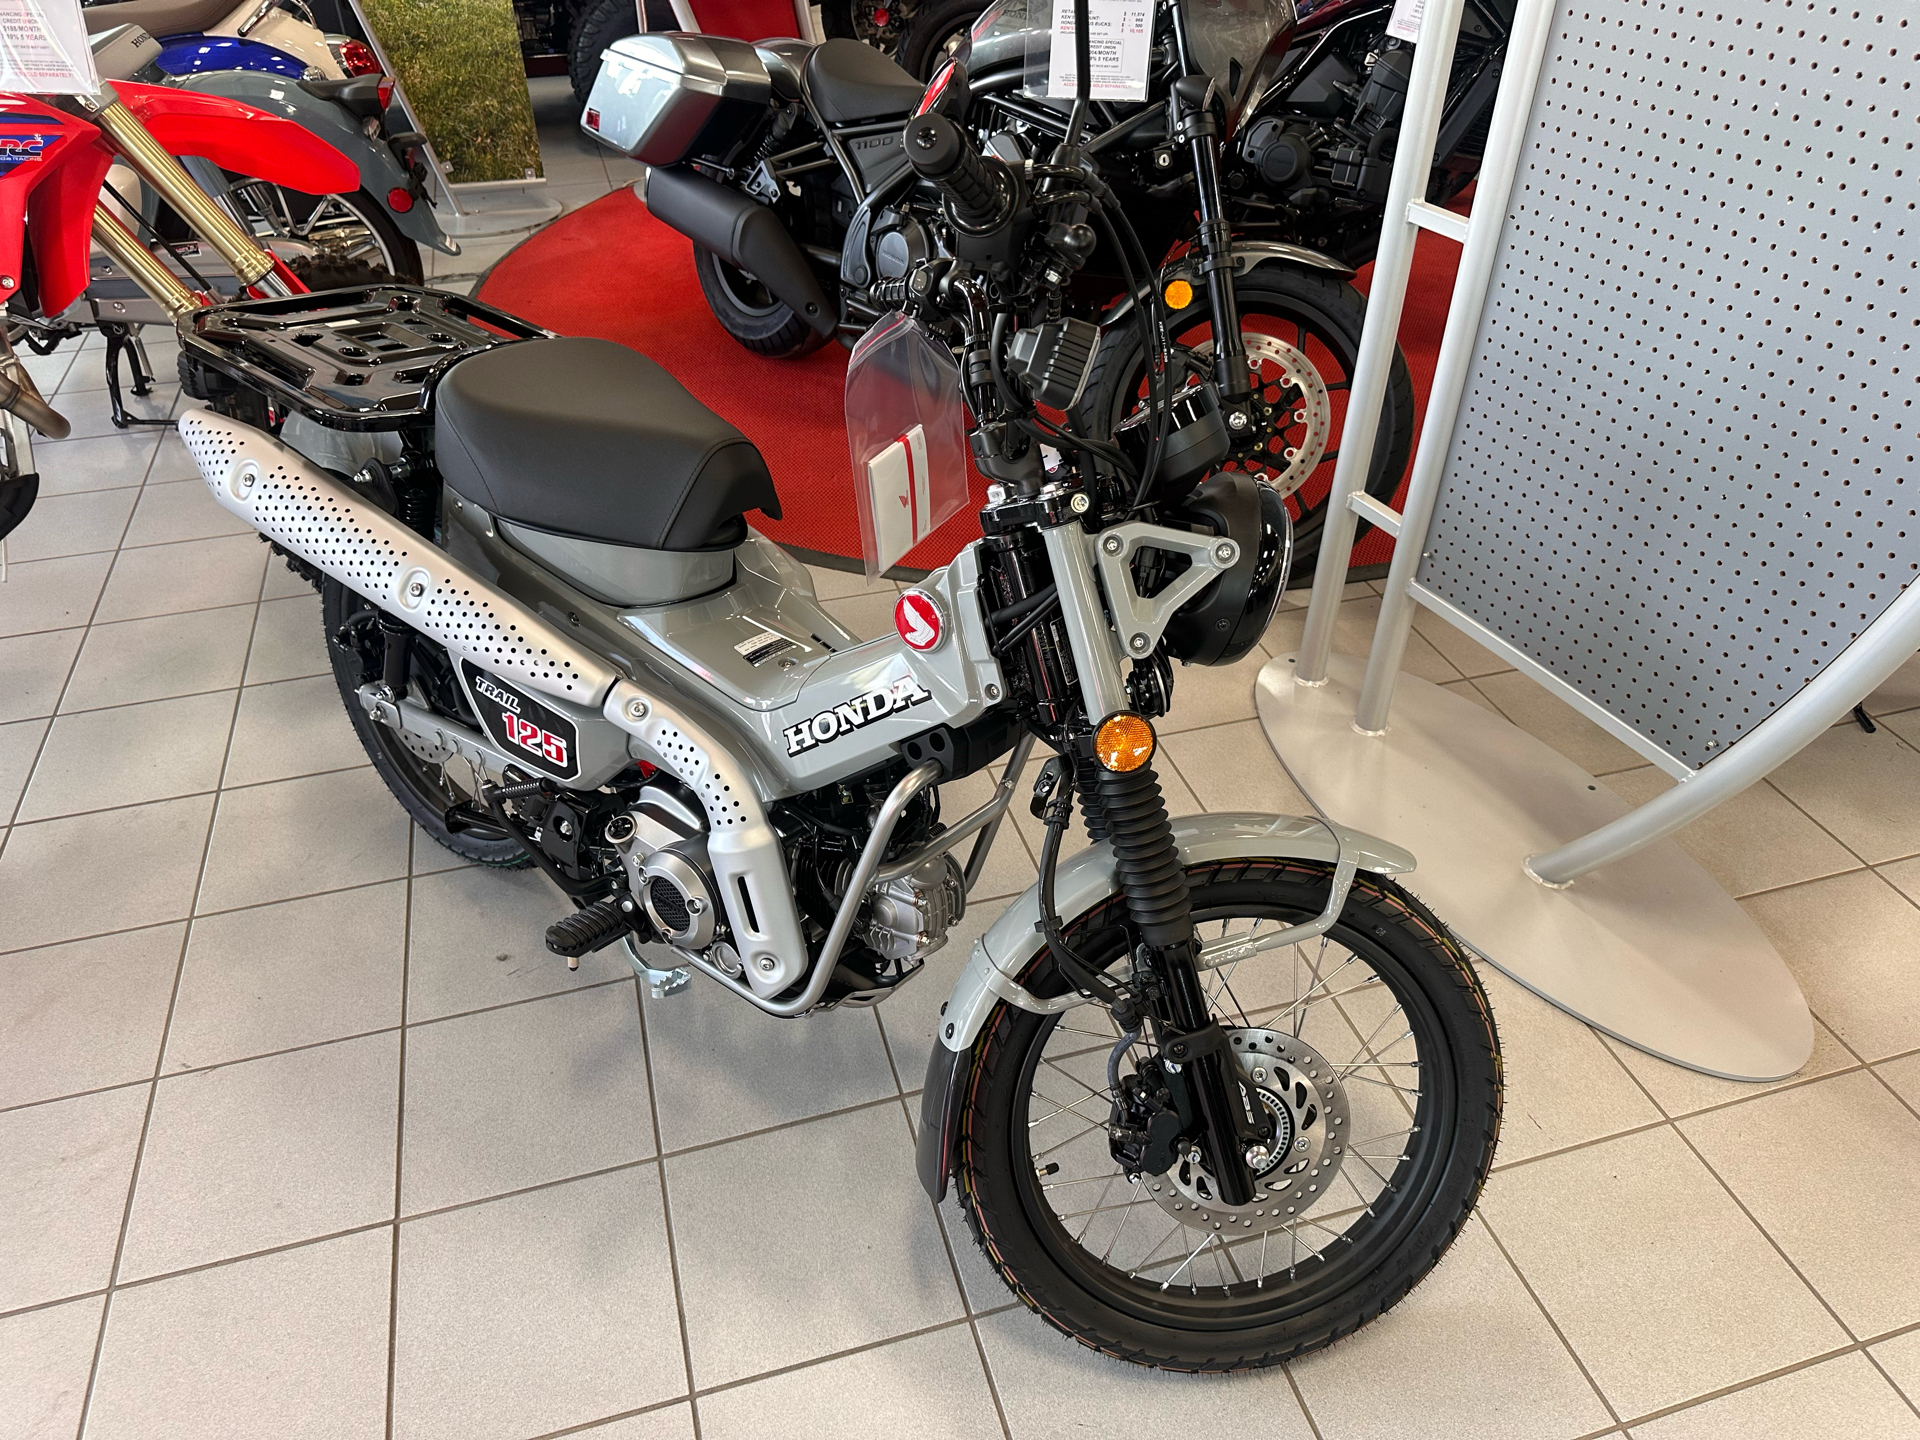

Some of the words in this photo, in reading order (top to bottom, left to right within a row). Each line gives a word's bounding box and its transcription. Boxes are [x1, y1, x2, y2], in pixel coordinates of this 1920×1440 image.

[856, 136, 894, 150] 1100
[476, 676, 520, 714] TRAIL
[783, 675, 932, 758] HONDA
[502, 712, 568, 768] 125
[1238, 1080, 1255, 1124] ABS
